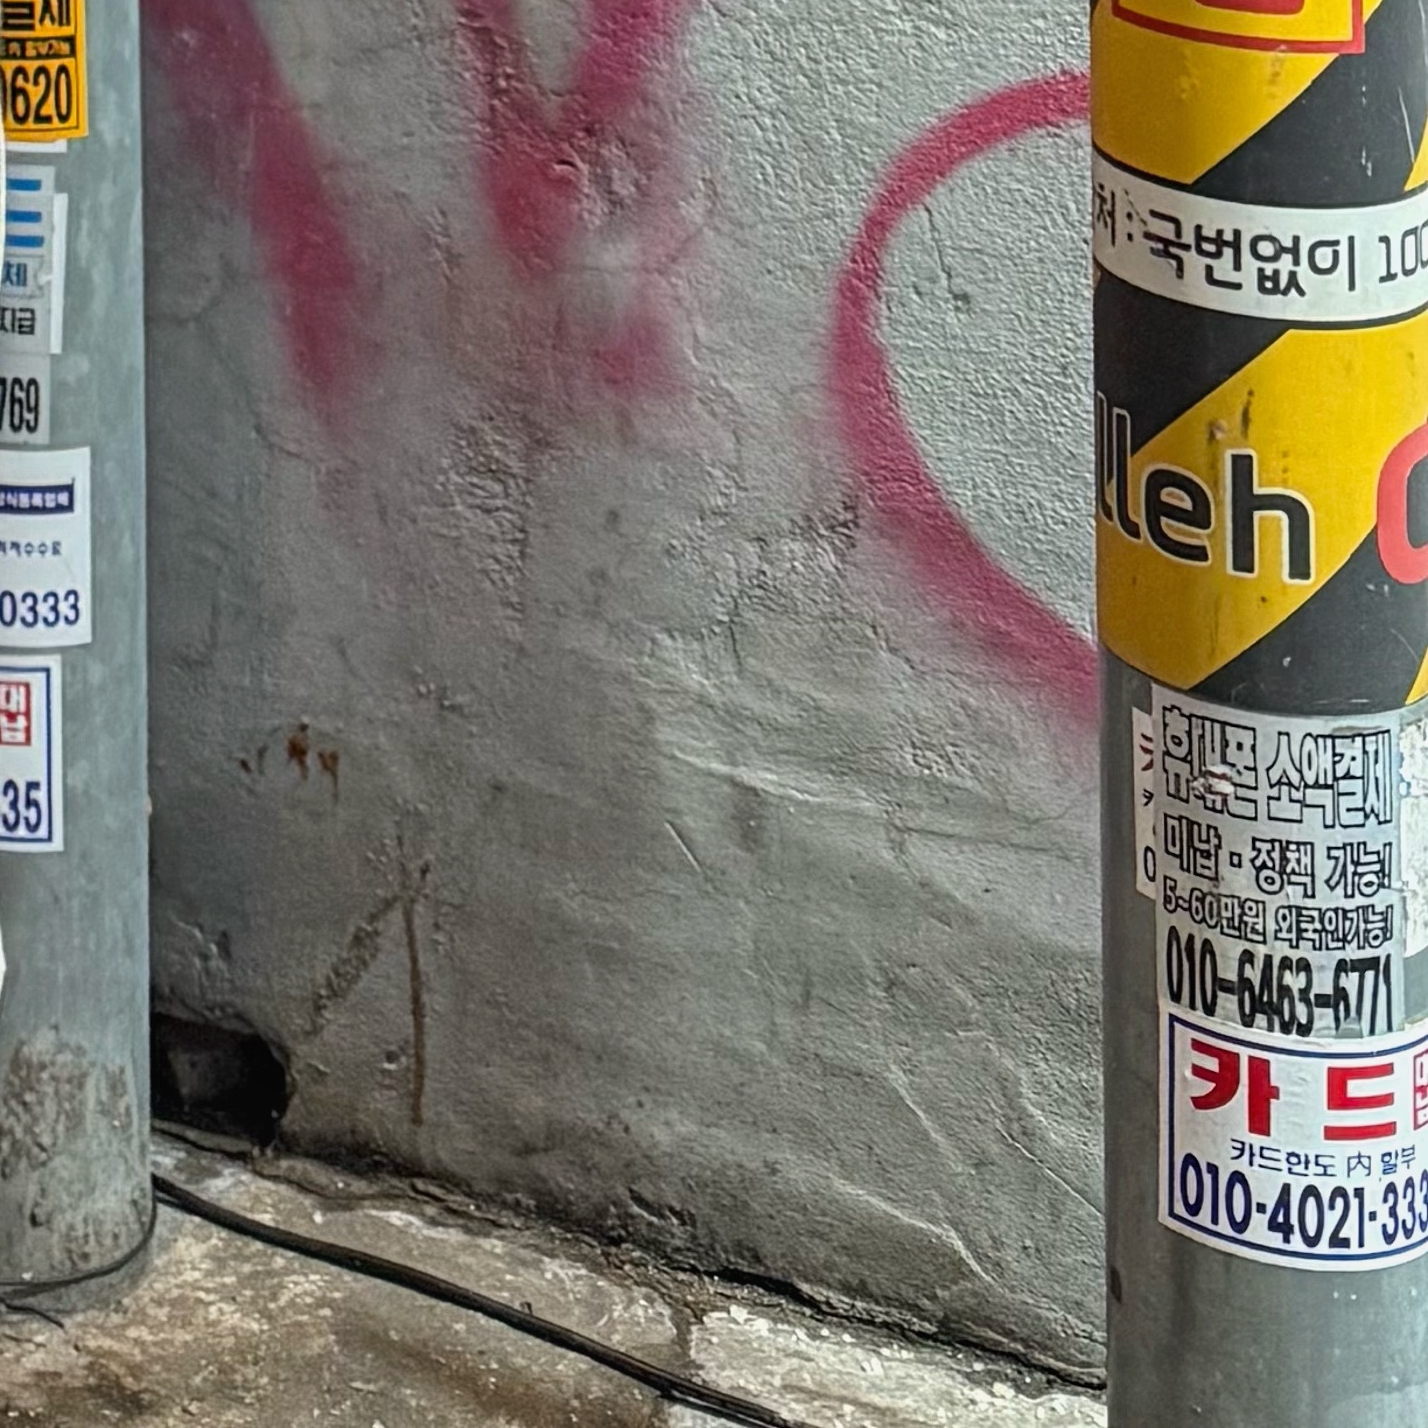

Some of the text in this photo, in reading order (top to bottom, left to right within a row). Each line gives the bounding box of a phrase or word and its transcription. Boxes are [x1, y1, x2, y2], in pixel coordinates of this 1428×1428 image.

[1142, 208, 1356, 298] 국번없이
[1265, 729, 1393, 829] 소액결제
[1163, 813, 1393, 899] 미납 정책 가능!
[1190, 1038, 1398, 1142] 카드
[1230, 1137, 1338, 1178] 카드한도
